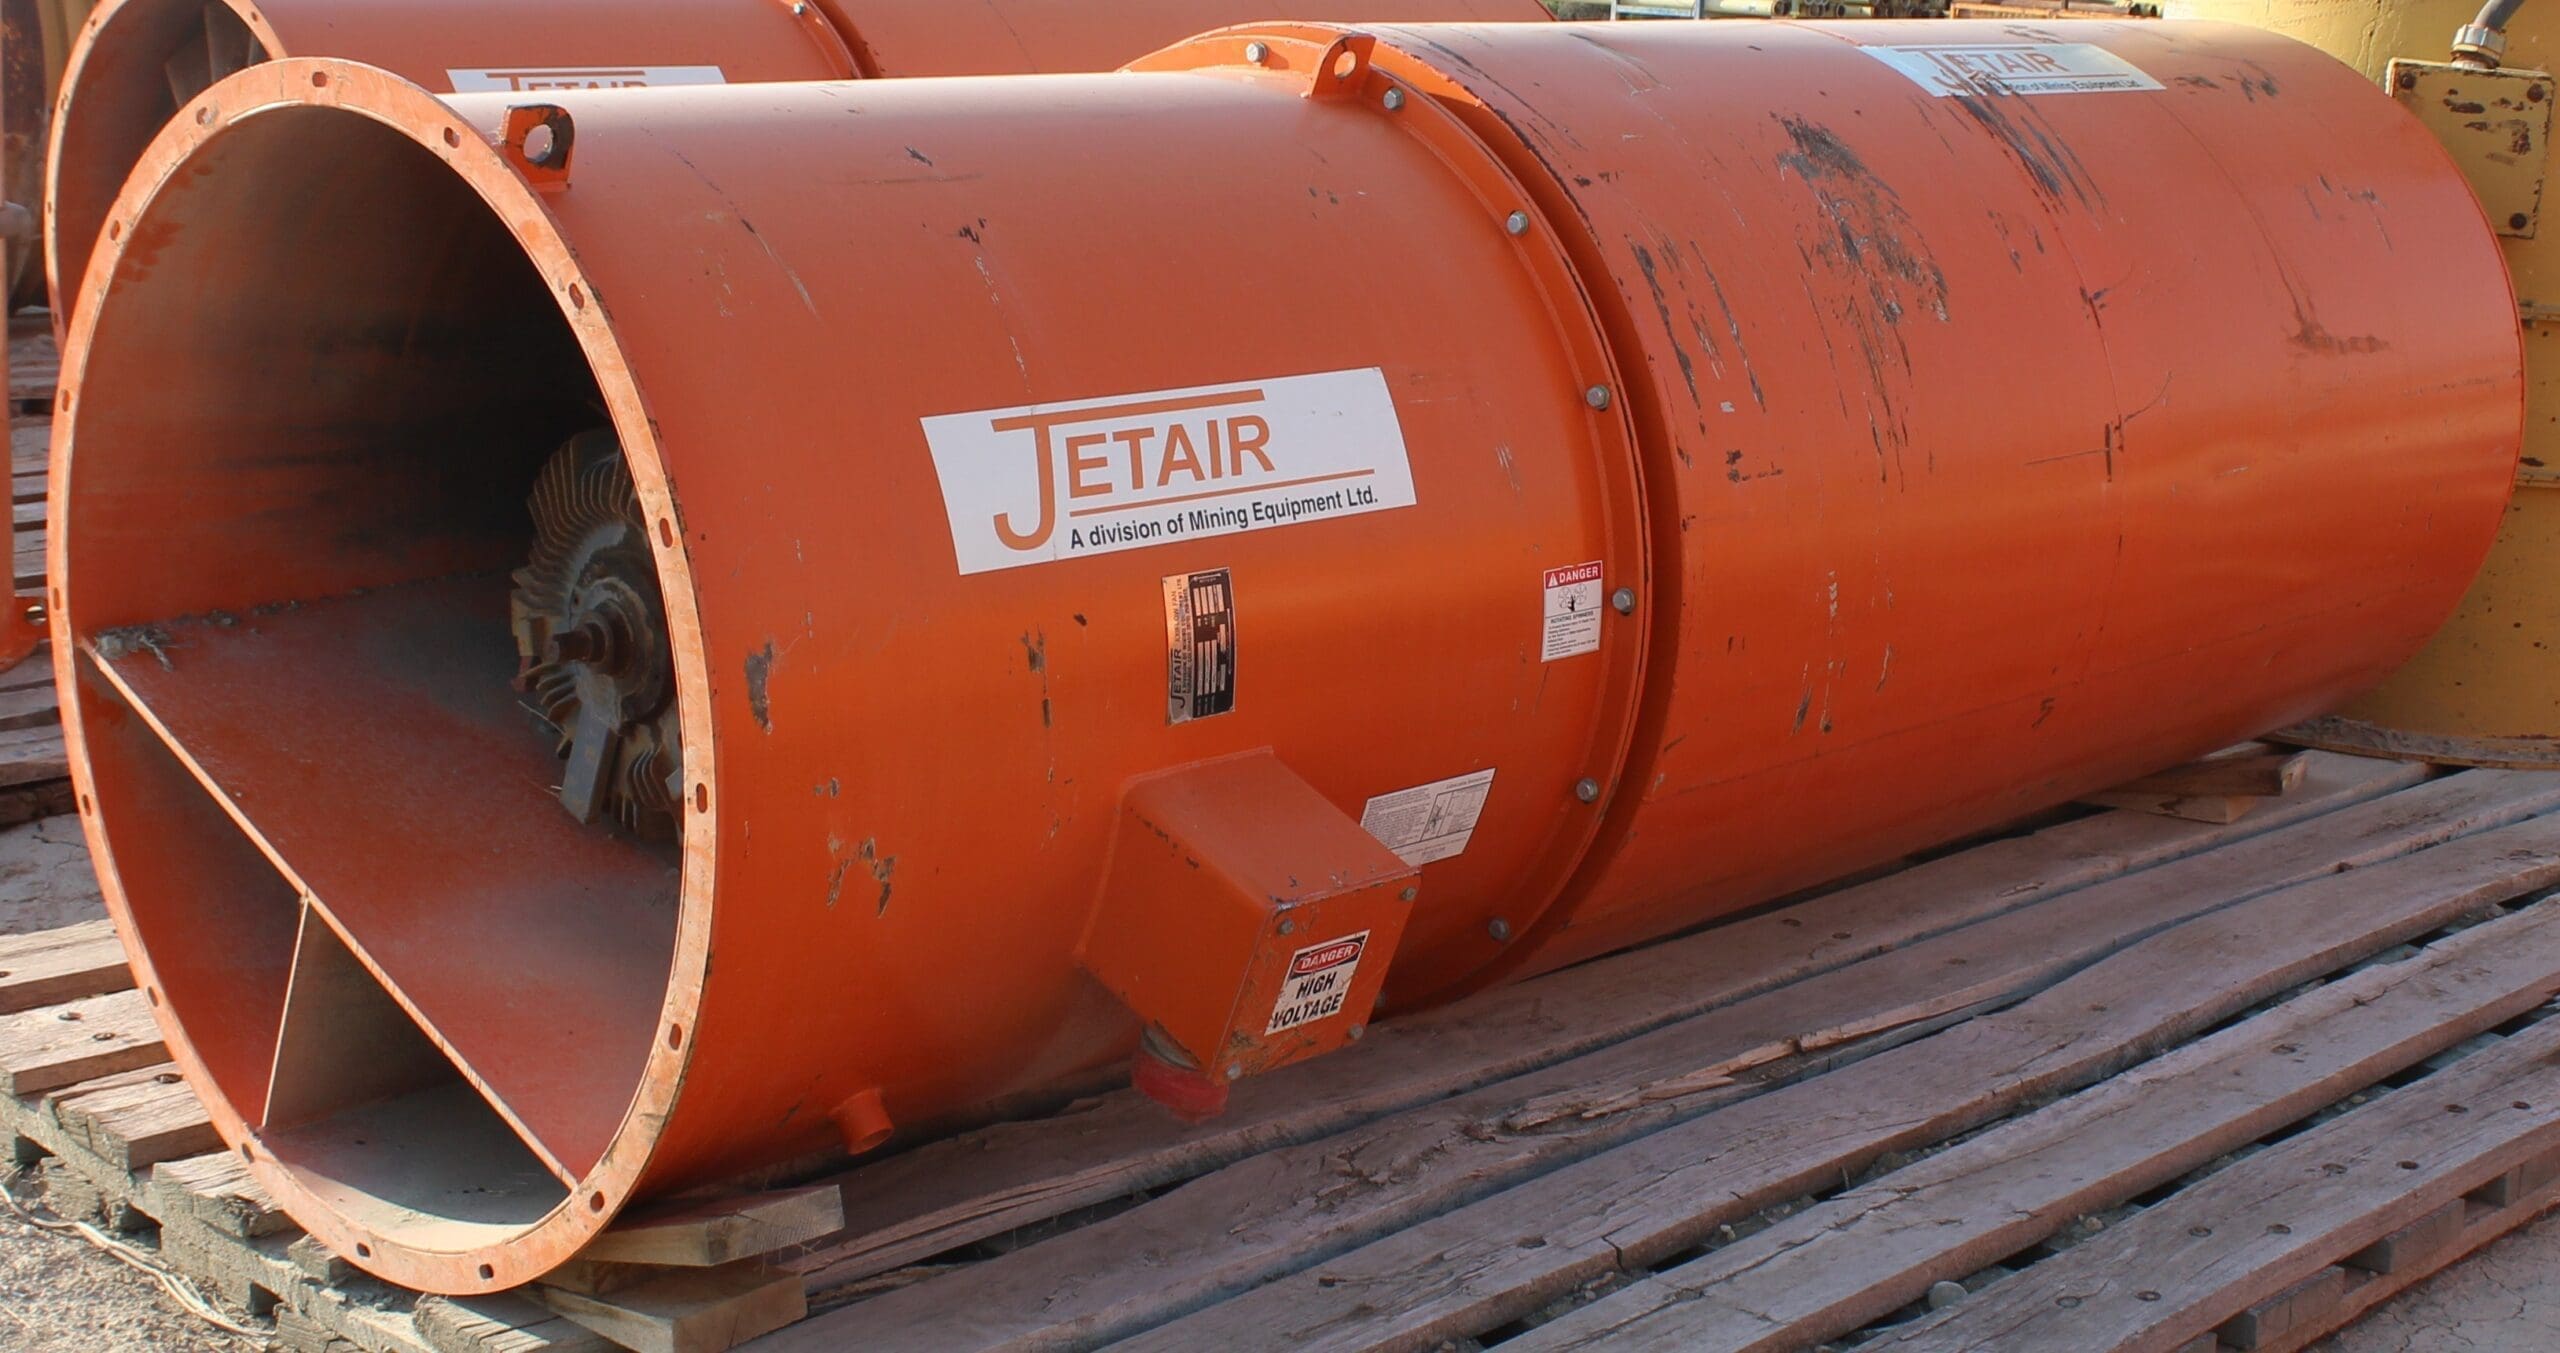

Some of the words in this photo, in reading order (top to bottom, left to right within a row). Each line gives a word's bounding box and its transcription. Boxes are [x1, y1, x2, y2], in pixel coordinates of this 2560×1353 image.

[1896, 46, 2070, 92] JETAIR
[991, 388, 1276, 552] JETAIR
[1070, 529, 1084, 549] A
[1089, 521, 1162, 547] division
[1167, 514, 1185, 535] of
[1188, 505, 1249, 529] Mining
[1252, 490, 1343, 521] Equipment
[1347, 485, 1378, 507] Ltd.
[1559, 566, 1599, 583] DANGER
[1170, 648, 1186, 709] JETAIR
[1301, 945, 1354, 970] DANGER
[1296, 971, 1338, 999] HIGH
[1272, 993, 1343, 1029] VOLTAGE
